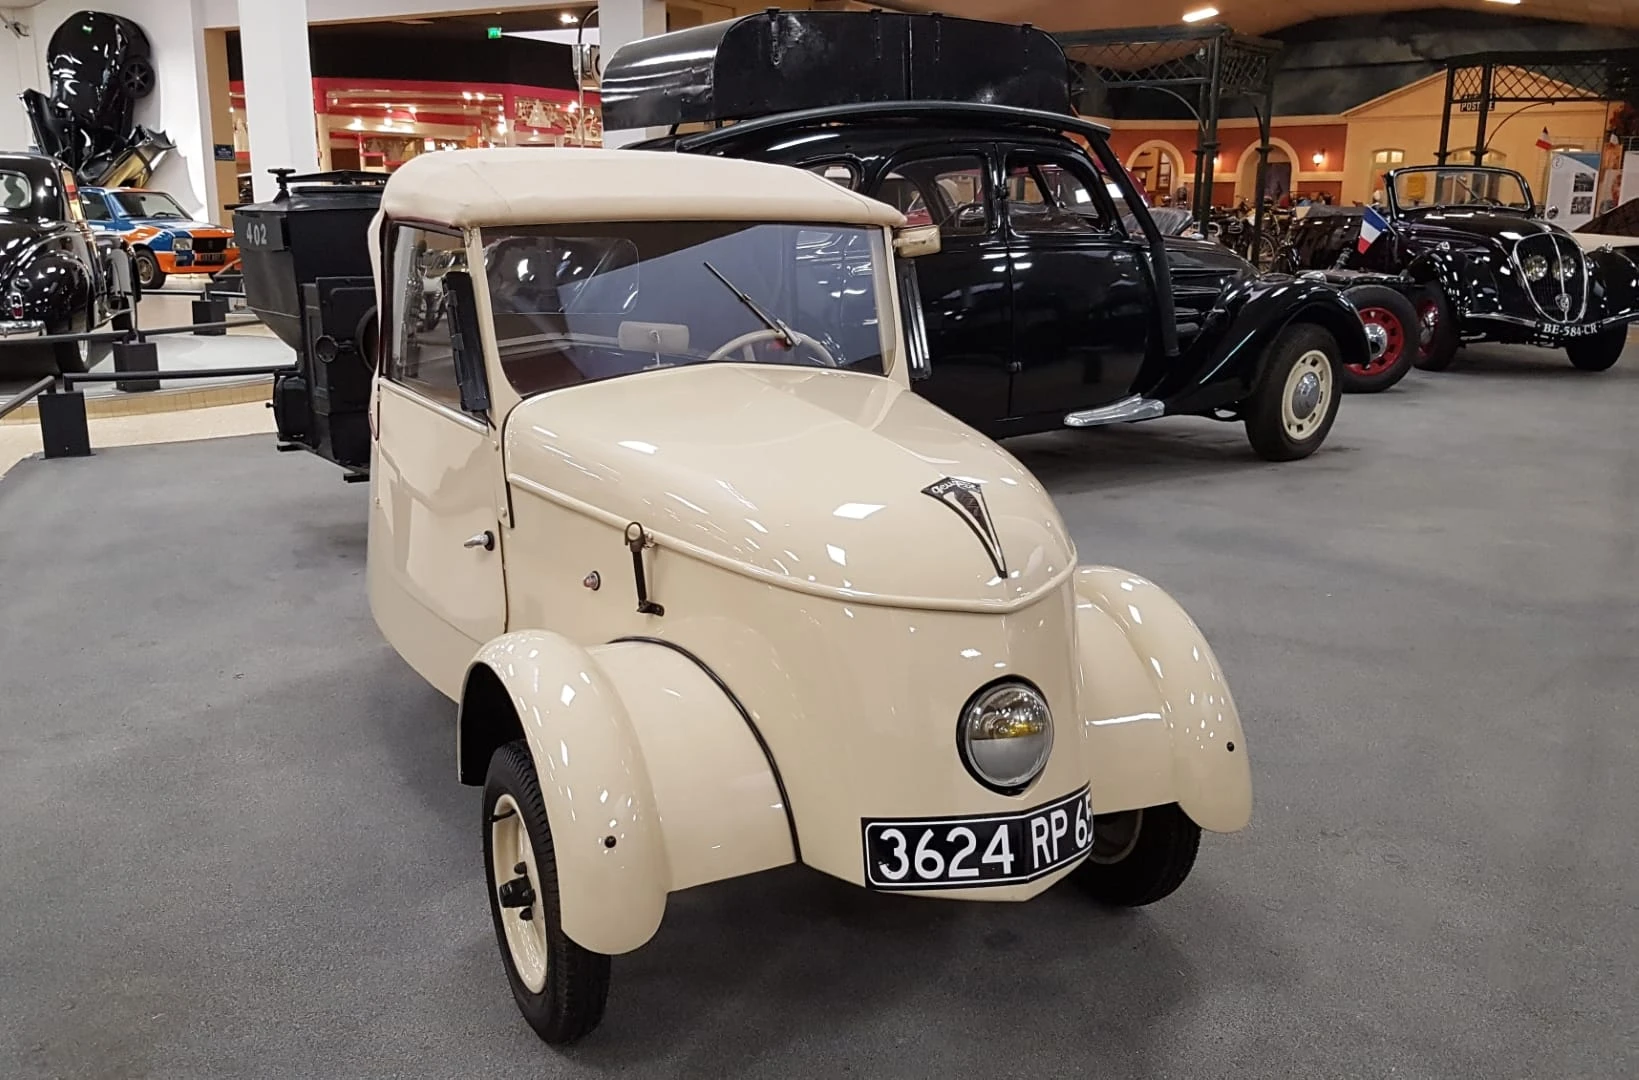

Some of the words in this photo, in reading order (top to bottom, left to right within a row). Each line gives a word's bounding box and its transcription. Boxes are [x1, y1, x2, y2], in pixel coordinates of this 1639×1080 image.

[246, 222, 267, 246] 402
[879, 824, 1014, 880] 3624
[1031, 809, 1068, 868] RP
